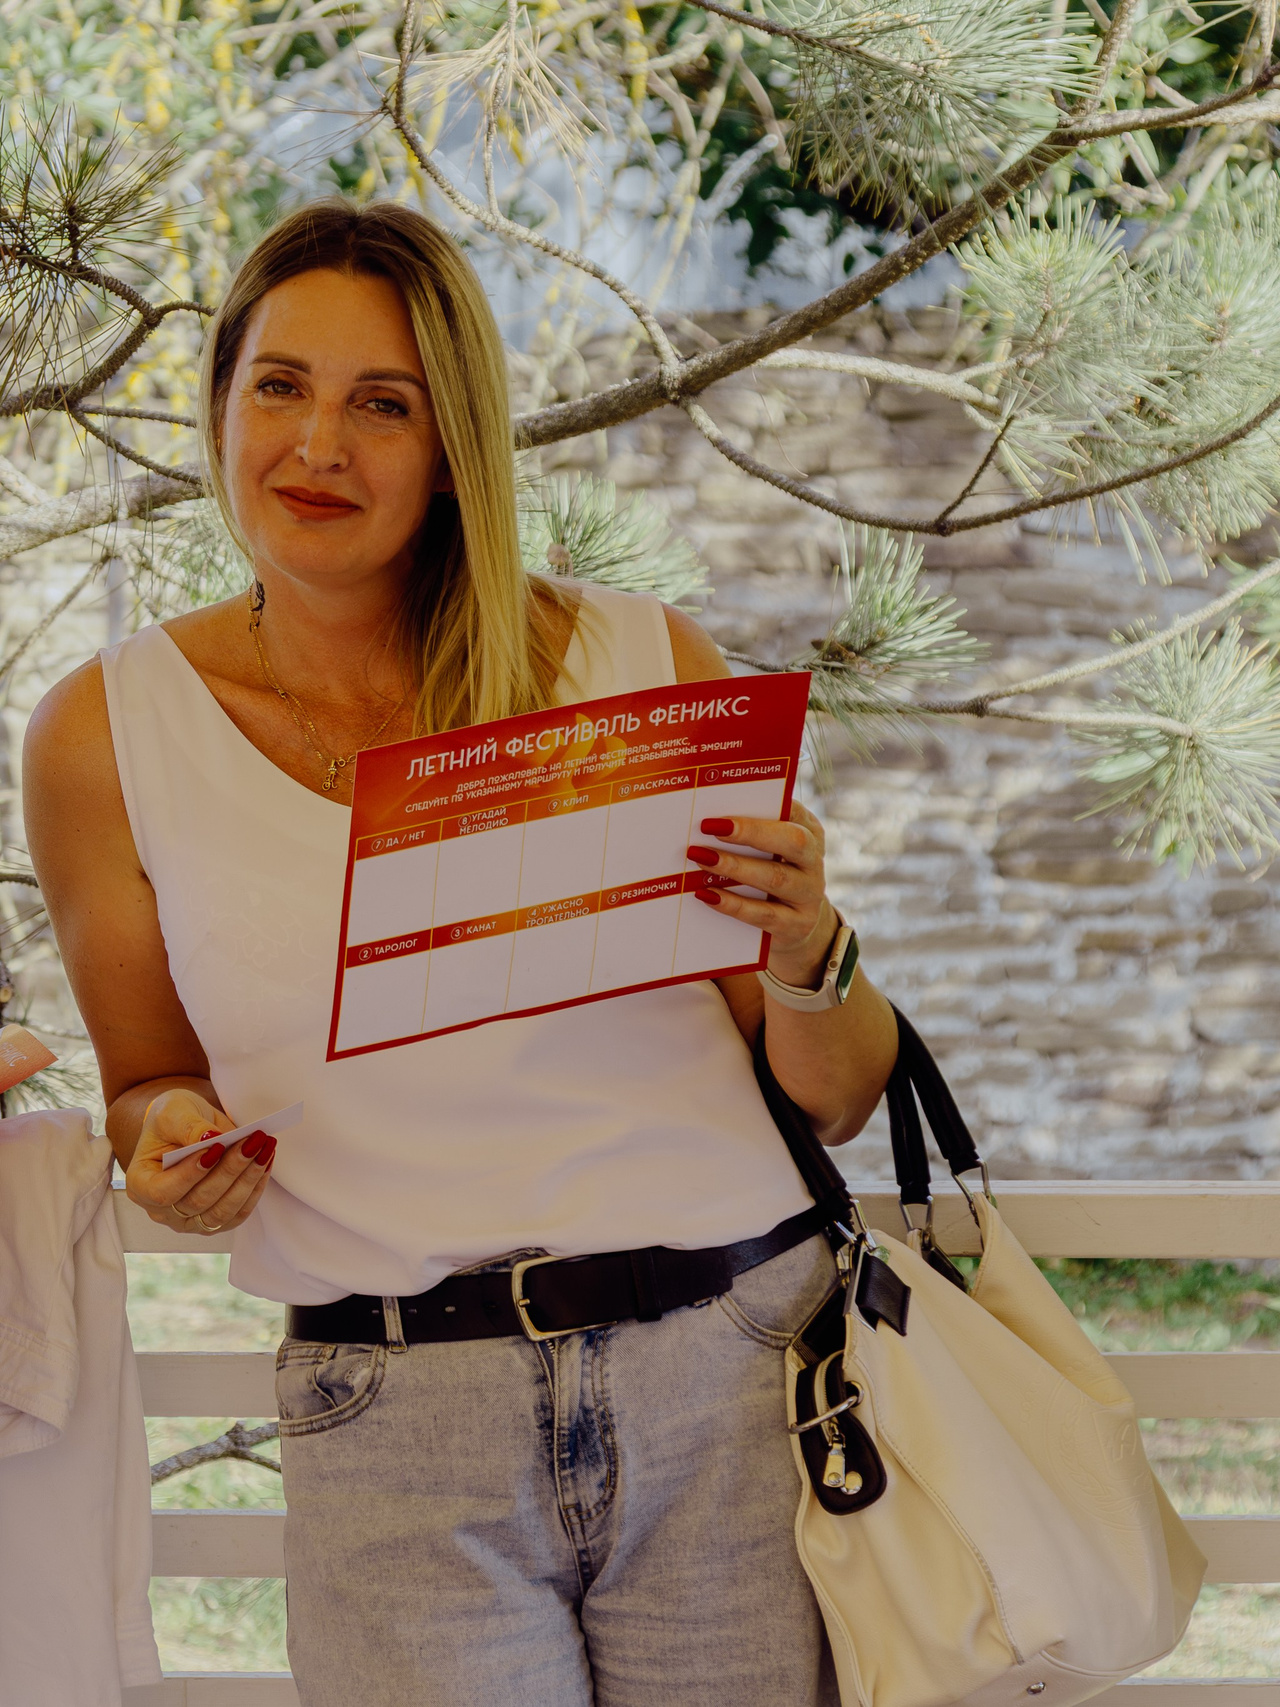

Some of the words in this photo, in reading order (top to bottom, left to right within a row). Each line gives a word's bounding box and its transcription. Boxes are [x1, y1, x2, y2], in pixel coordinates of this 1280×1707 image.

[406, 737, 498, 780] ЛЕТНИЙ
[505, 712, 641, 758] ФЕСТИВАЛЬ
[648, 695, 751, 727] ФЕНИКС
[405, 795, 450, 814] СЛЕДУЙТЕ
[451, 793, 464, 803] ПО
[466, 780, 523, 800] УКАЗАННОМУ
[524, 770, 571, 787] МАРШРУТУ
[573, 767, 581, 777] И
[582, 756, 627, 774] ПОЛУЧИТЕ
[628, 745, 698, 766] НЕЗАБЫВАЕМЫЕ
[700, 740, 743, 753] ЭМОЦИИ!
[455, 779, 486, 794] ДОБРО
[487, 766, 548, 786] ПОЖАЛОВАТЬ
[550, 762, 562, 771] НА
[563, 753, 597, 769] ЛЕТНИЙ
[599, 744, 651, 762] ФЕСТИВАЛЬ
[722, 764, 782, 778] МЕДИТАЦИЯ
[632, 775, 691, 792] РАСКРАСКА
[562, 794, 590, 808] КЛИП
[470, 805, 507, 822] УГАДАЙ
[459, 817, 510, 836] МЕЛОДИЮ
[385, 837, 400, 848] ДА
[401, 834, 407, 844] /
[408, 830, 426, 842] НЕТ
[620, 881, 677, 900] РЕЗИНОЧКИ
[541, 898, 584, 915] УЖАСНО
[525, 906, 590, 928] ТРОГАТЕЛЬНО
[466, 921, 497, 935] КАНАТ
[374, 938, 418, 955] ТАРОЛОГ
